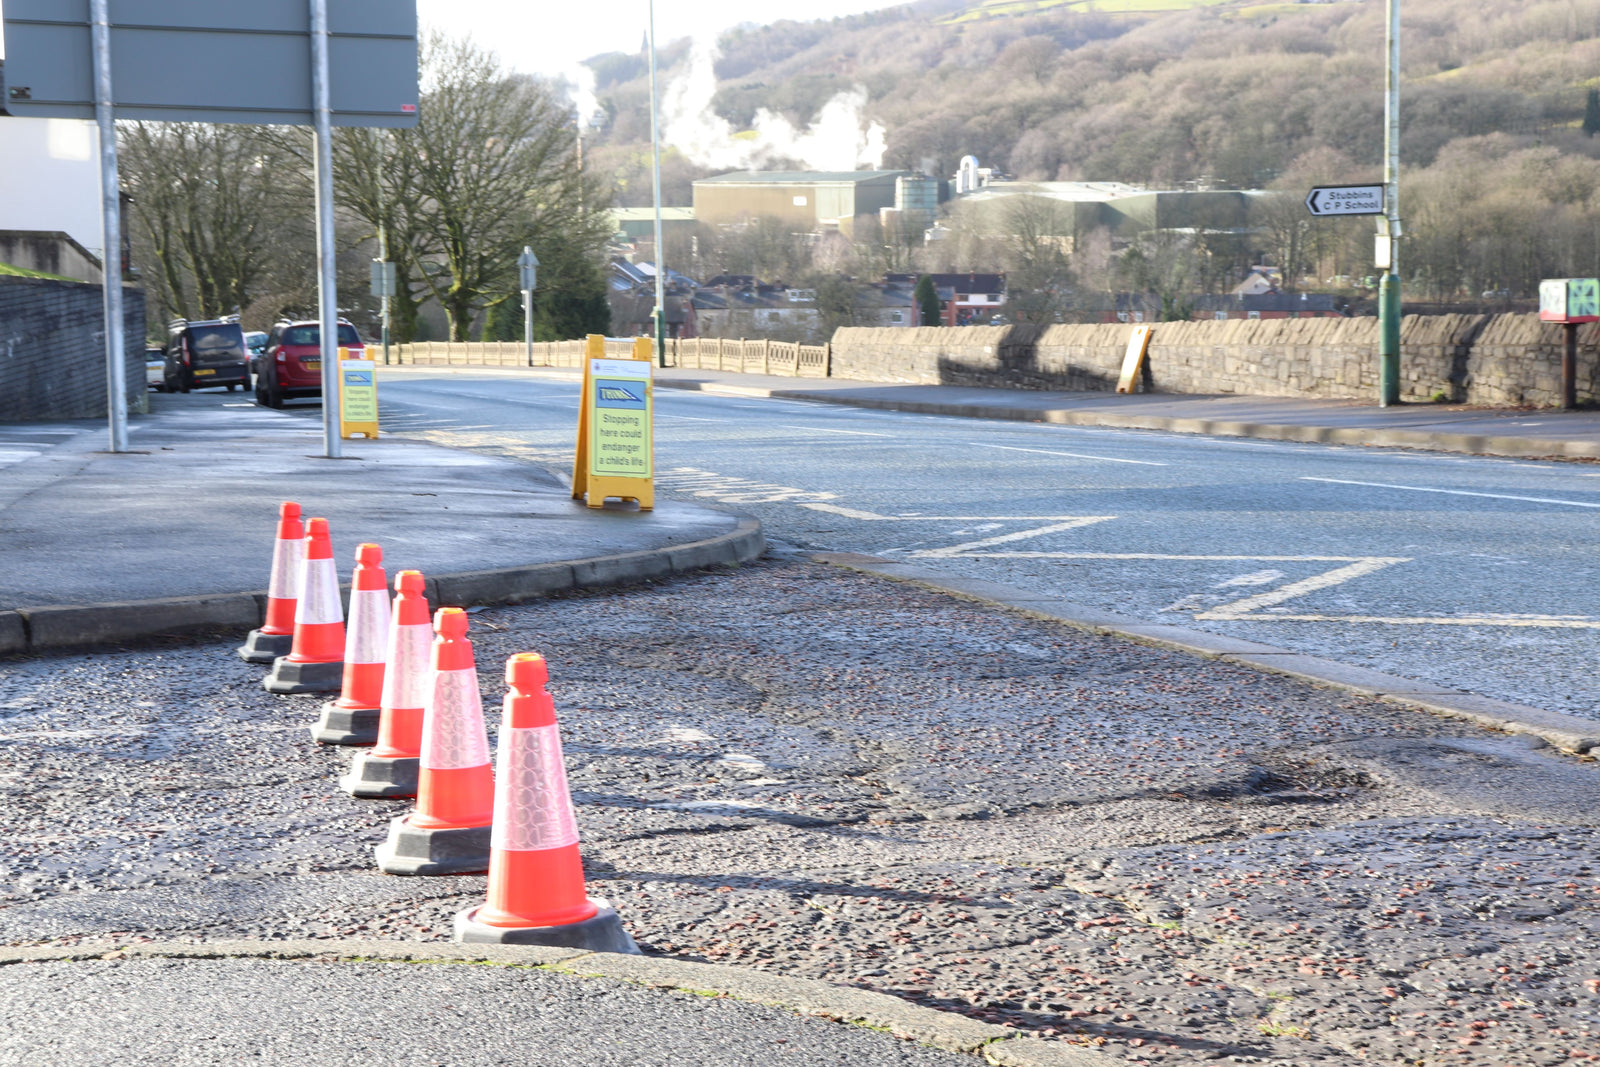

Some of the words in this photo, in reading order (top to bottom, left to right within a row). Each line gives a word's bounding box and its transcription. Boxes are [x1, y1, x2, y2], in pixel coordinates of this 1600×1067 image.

[1329, 191, 1373, 200] Stubbins
[1324, 202, 1331, 210] C
[1335, 201, 1341, 209] P
[1345, 200, 1378, 209] School
[603, 414, 640, 426] Stopping
[600, 428, 618, 438] here
[620, 429, 642, 438] could
[602, 442, 640, 454] endanger
